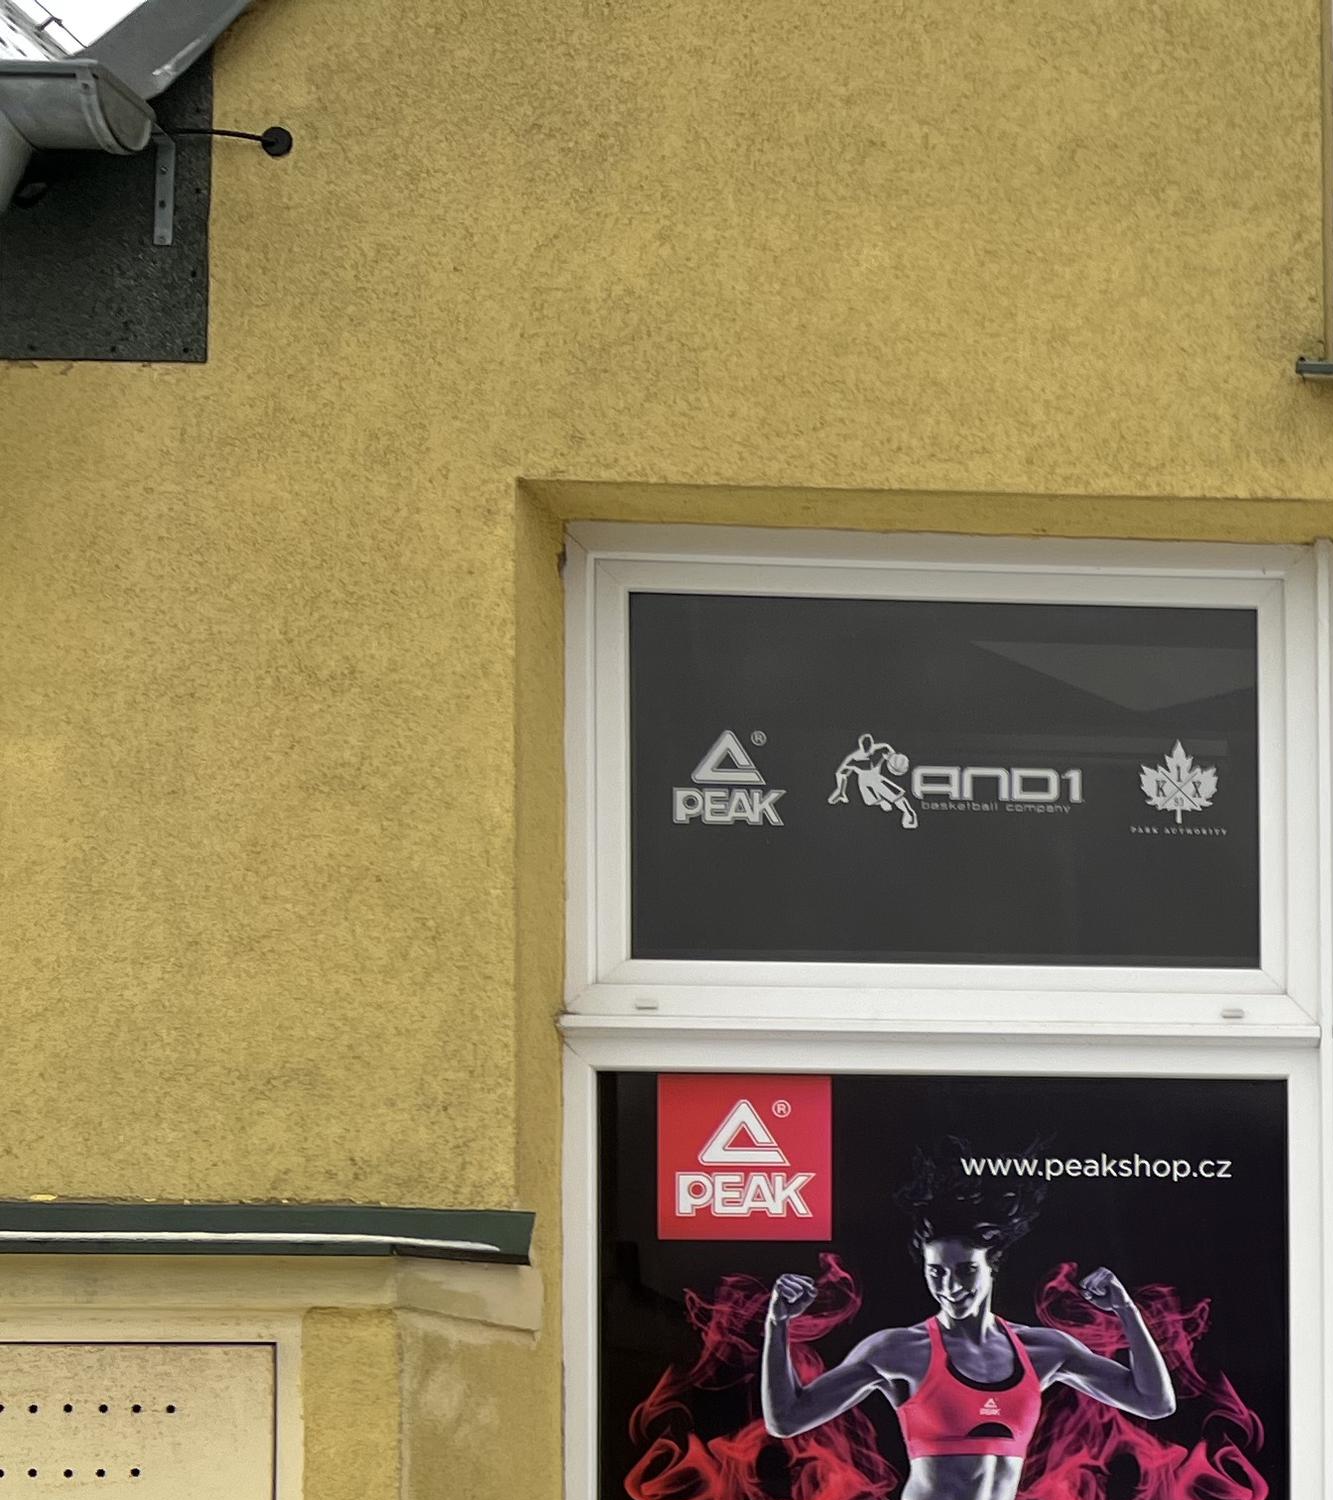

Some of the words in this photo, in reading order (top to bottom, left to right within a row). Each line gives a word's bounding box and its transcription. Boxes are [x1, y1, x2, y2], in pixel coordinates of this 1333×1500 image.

[911, 765, 1084, 803] AND1
[672, 786, 787, 826] PEAK
[920, 800, 998, 812] basketball
[1005, 803, 1071, 814] company
[960, 1153, 1233, 1182] www.peakshop.cz
[675, 1171, 815, 1218] PEAK
